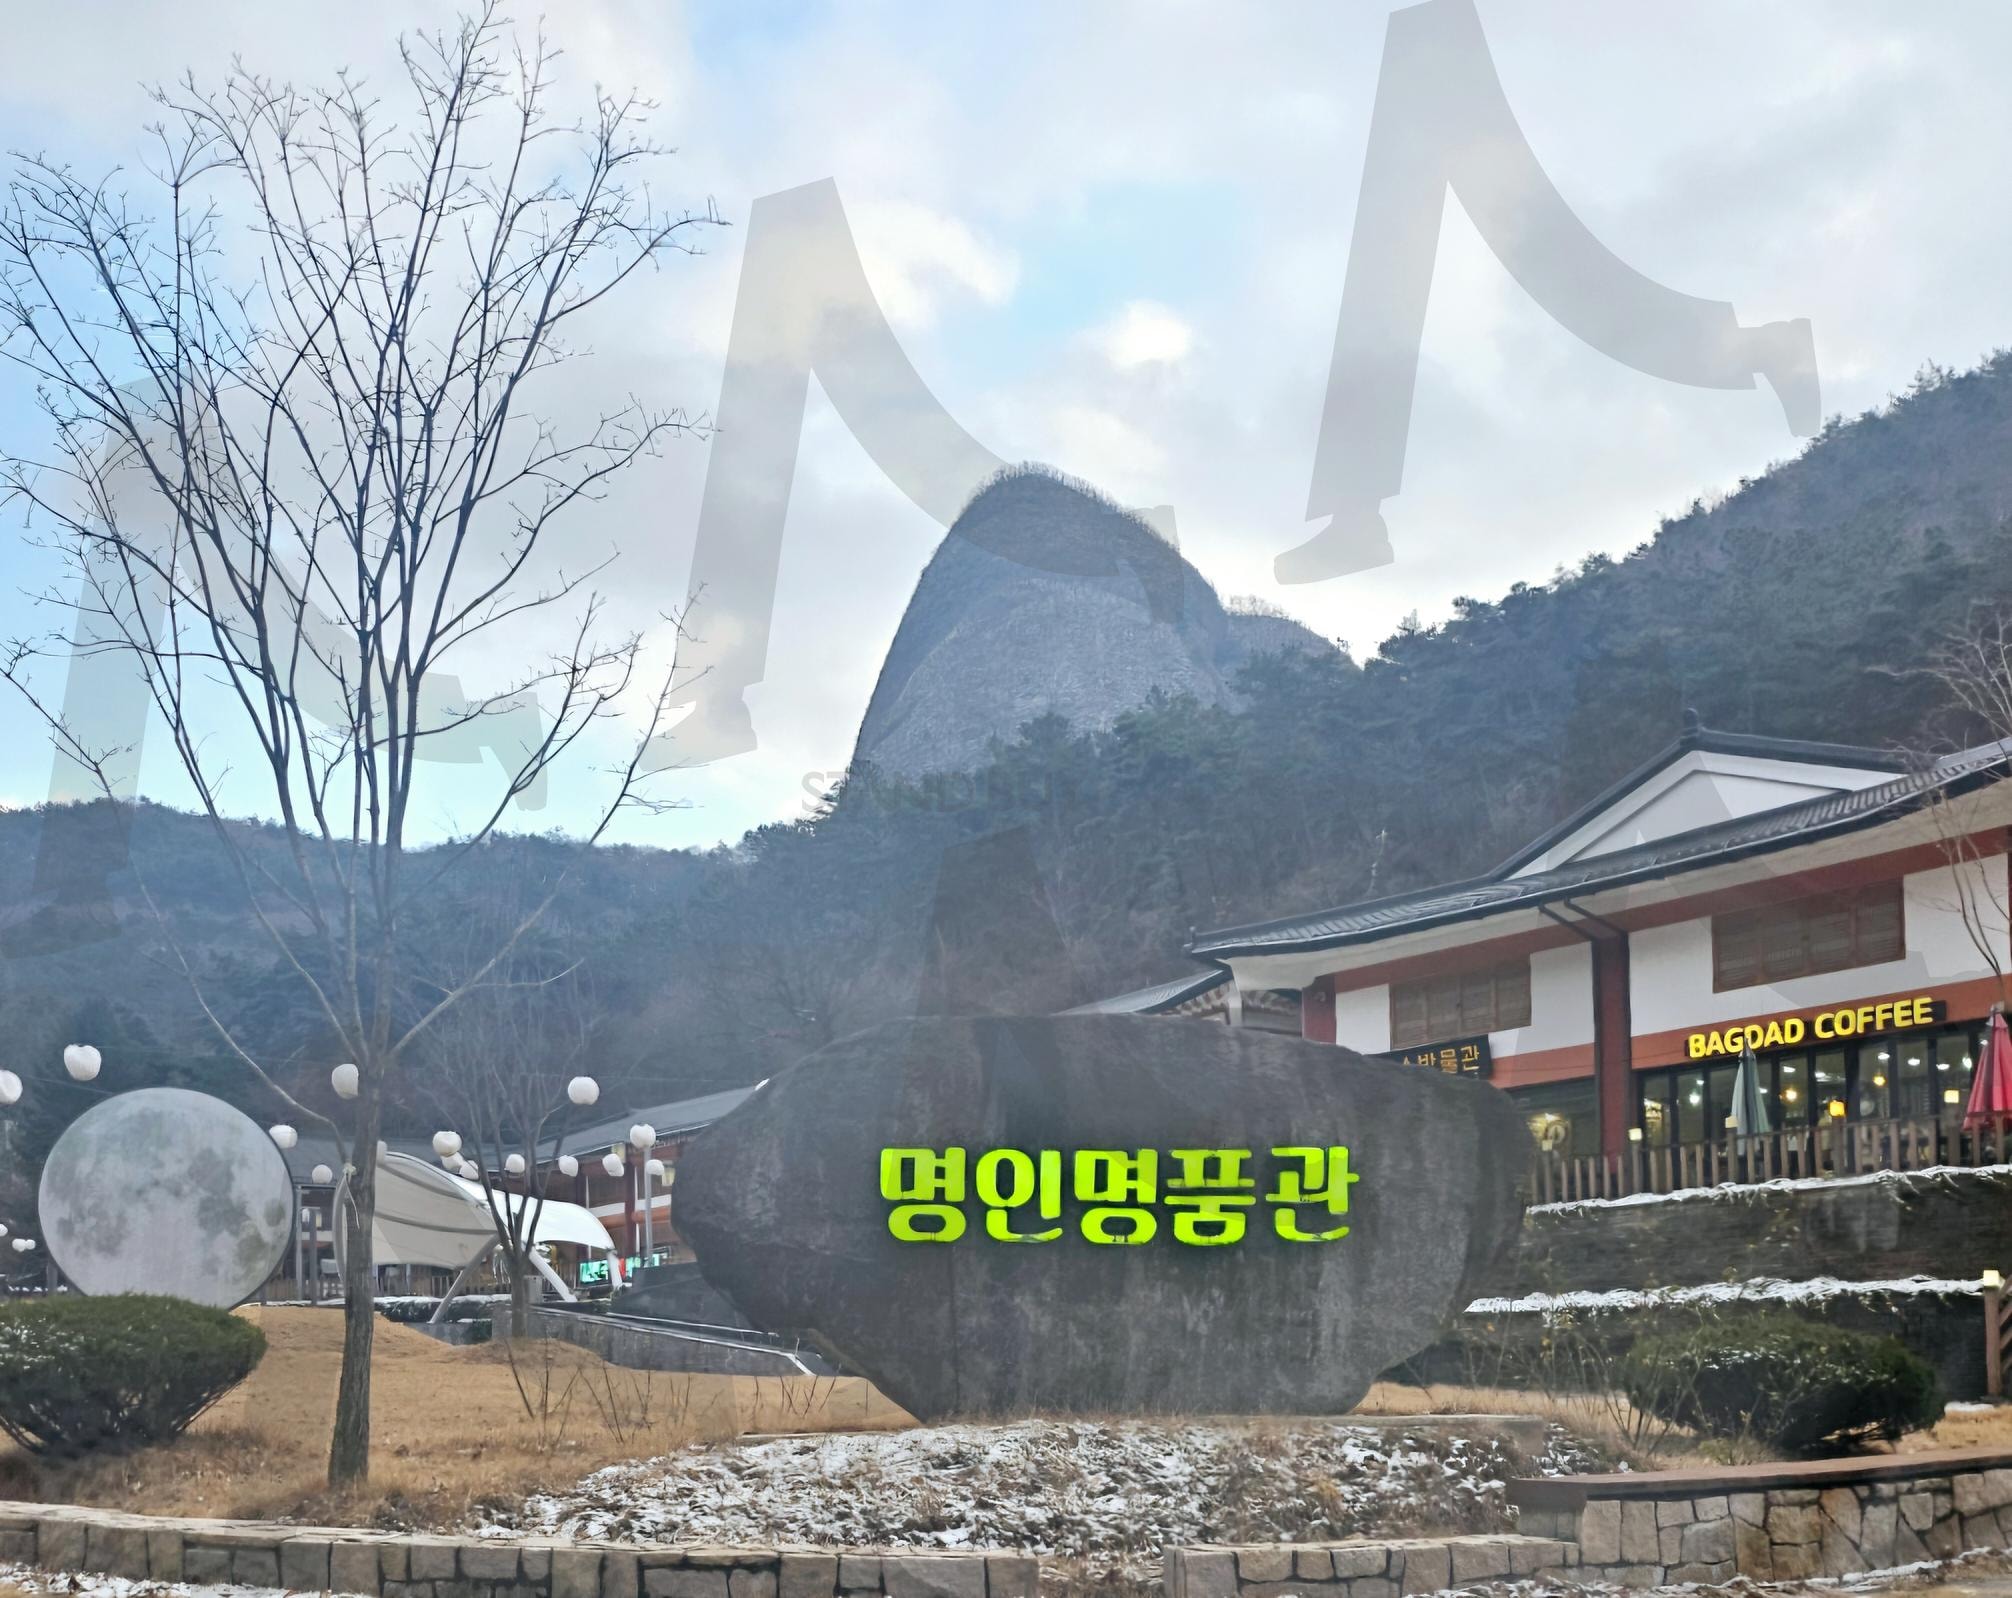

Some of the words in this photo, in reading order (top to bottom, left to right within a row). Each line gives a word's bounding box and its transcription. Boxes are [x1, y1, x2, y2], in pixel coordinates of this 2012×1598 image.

[1688, 1018, 1805, 1059] BAGDAD
[1814, 997, 1933, 1039] COFFEE
[880, 1146, 1361, 1246] 명인명품관
